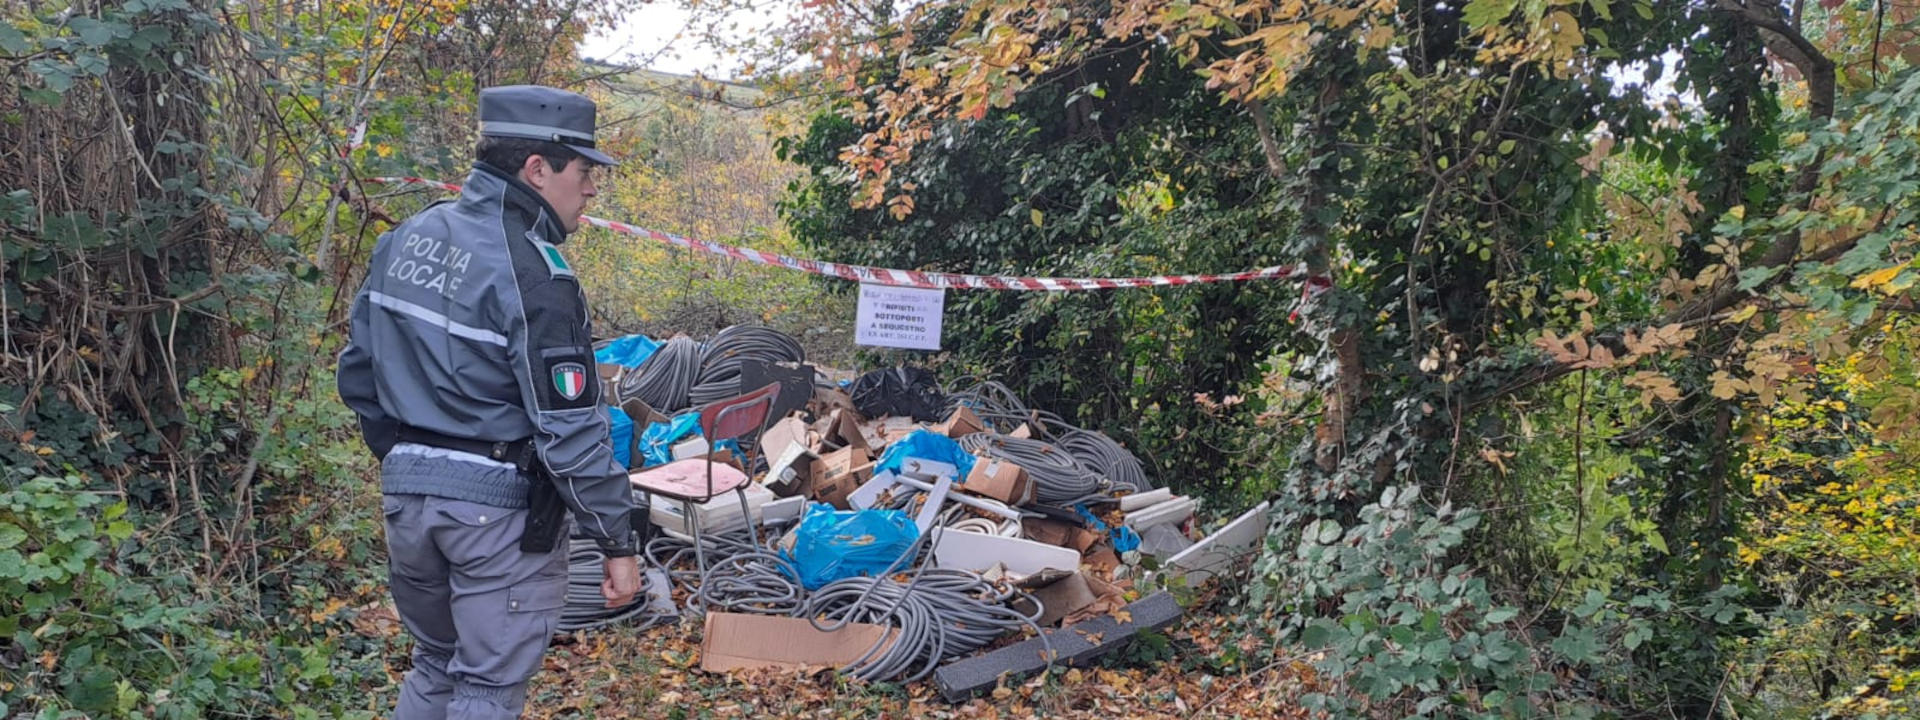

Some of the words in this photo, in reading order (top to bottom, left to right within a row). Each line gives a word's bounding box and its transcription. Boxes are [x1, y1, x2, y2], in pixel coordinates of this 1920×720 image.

[387, 256, 463, 298] LOCAE
[875, 313, 925, 323] SOTTOPOSTI
[879, 323, 926, 333] SEQUESTRO
